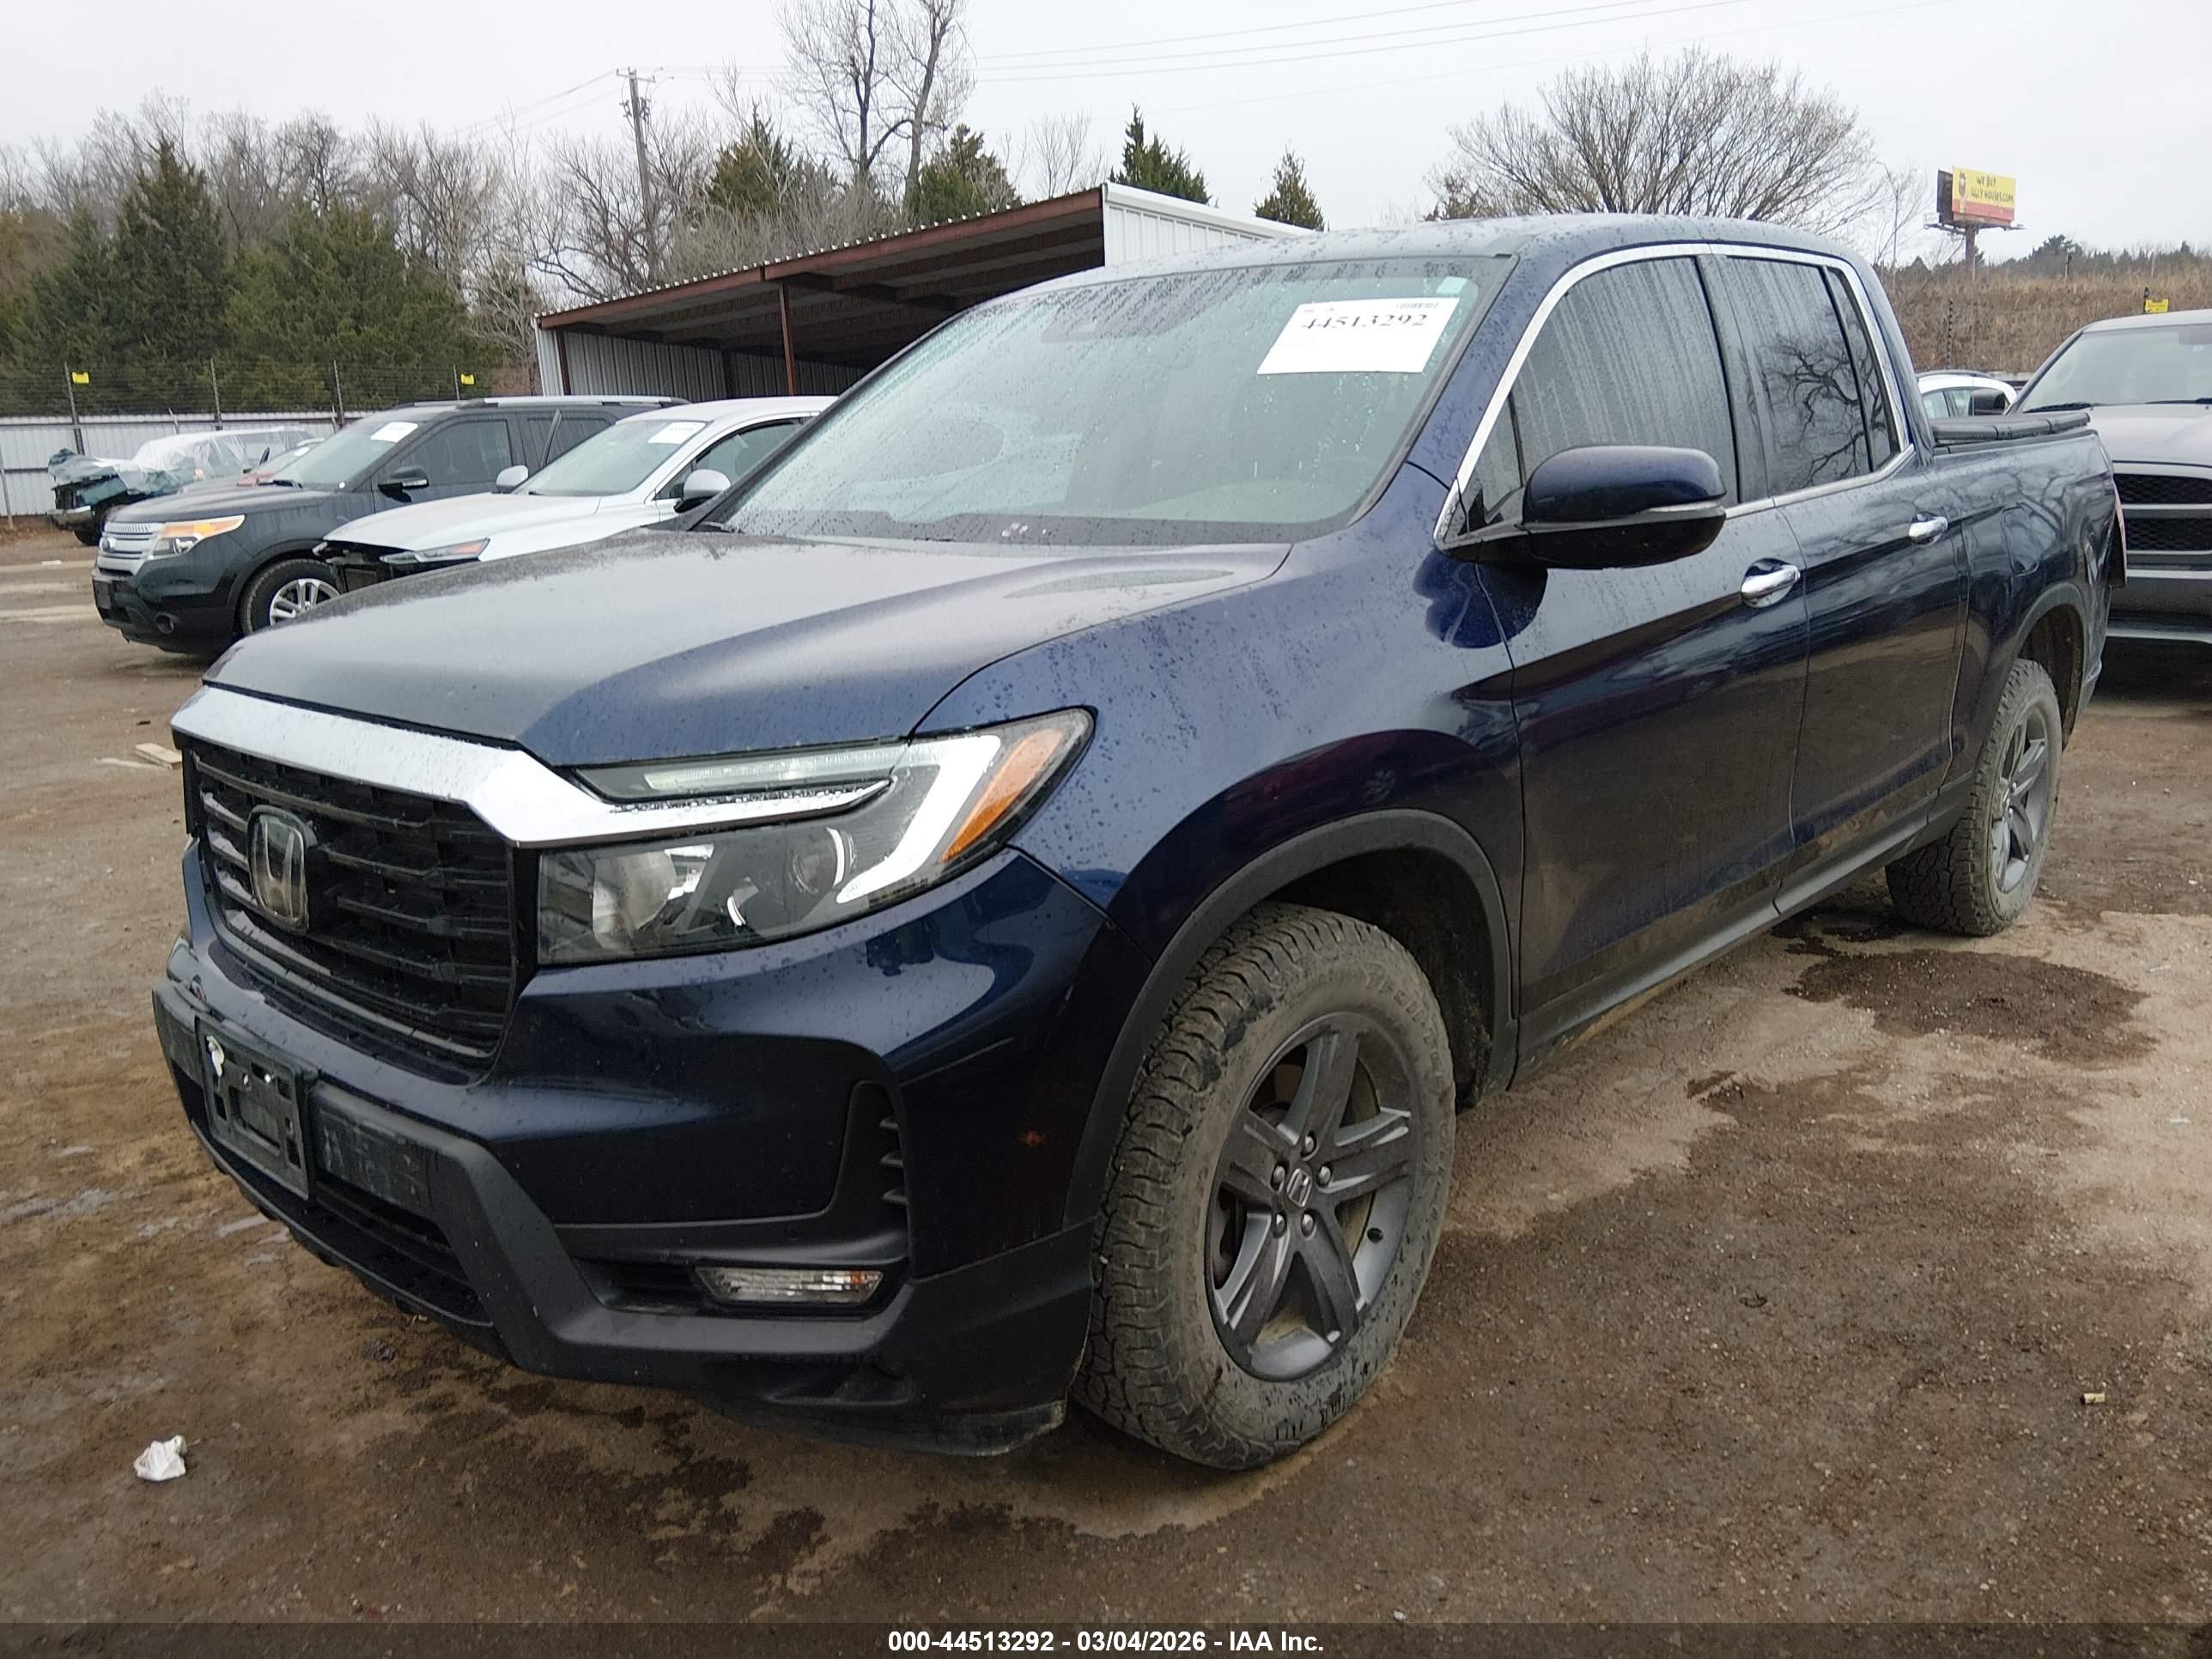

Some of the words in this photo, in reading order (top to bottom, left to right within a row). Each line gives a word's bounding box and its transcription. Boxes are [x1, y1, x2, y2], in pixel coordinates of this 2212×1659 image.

[1977, 176, 1984, 186] WE
[1986, 176, 1996, 187] BUY
[1971, 188, 1983, 199] UGLY
[1301, 313, 1429, 330] 44513292
